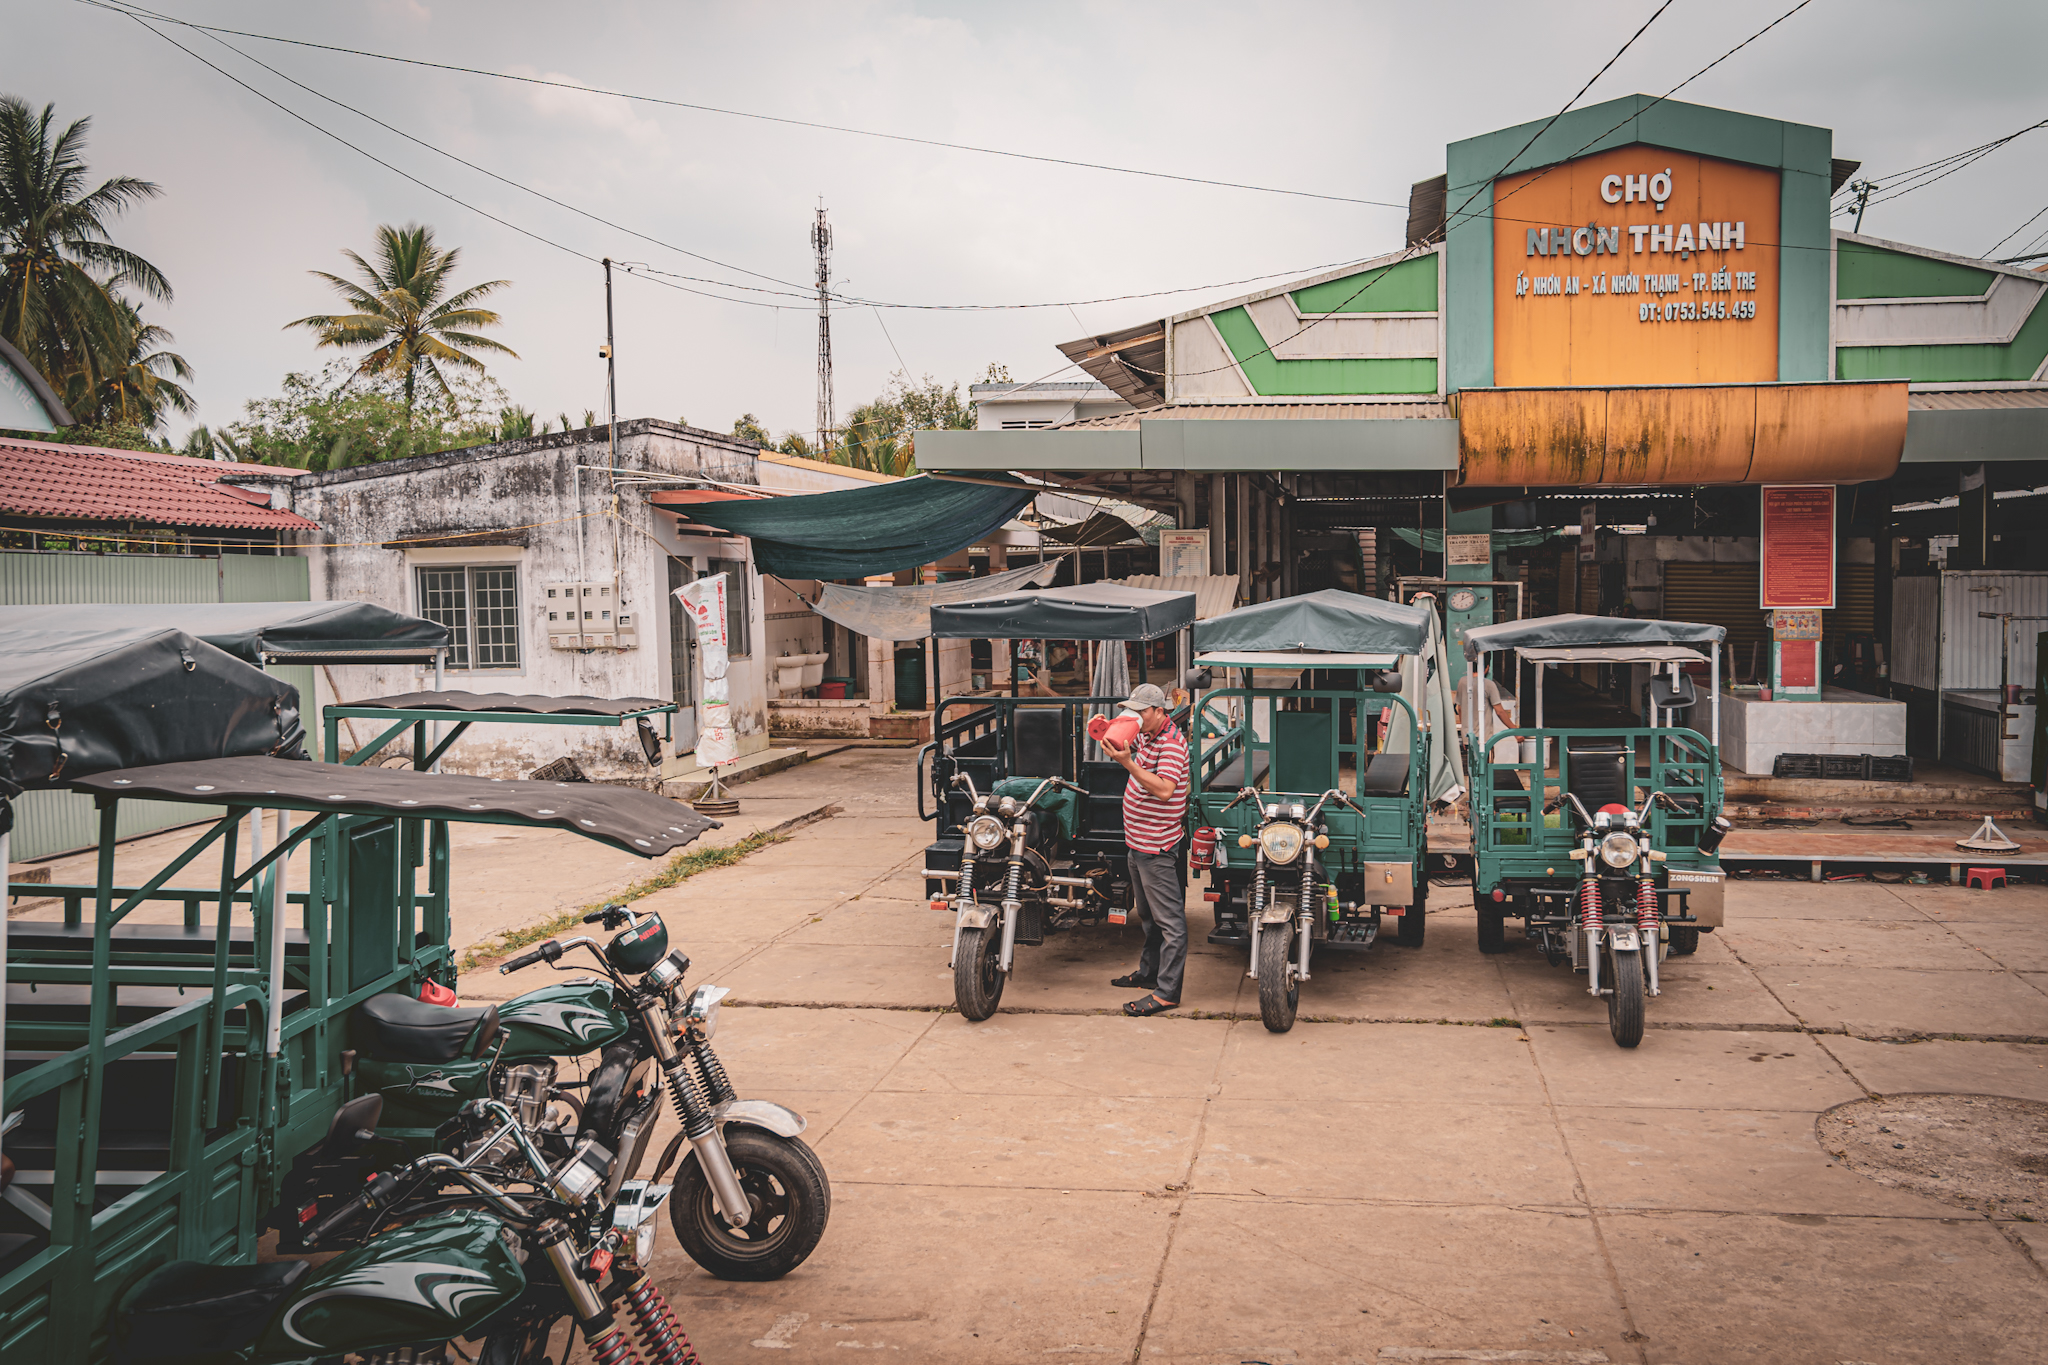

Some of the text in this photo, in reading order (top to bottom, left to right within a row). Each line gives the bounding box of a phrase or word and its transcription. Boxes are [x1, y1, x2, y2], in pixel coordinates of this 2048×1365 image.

[1600, 168, 1673, 211] CHỢ
[1526, 221, 1745, 260] NHƠN THẠNH
[1516, 270, 1529, 296] ẤP
[1533, 273, 1561, 296] NHƠN
[1565, 275, 1580, 296] AN
[1611, 271, 1640, 294] NHƠN
[1644, 273, 1679, 298] THẠNH
[1735, 271, 1756, 291] TRE
[1639, 300, 1756, 321] ĐT: 0753.545.459
[1670, 874, 1719, 883] ZONGSHEN
[638, 924, 661, 942] KIRIN
